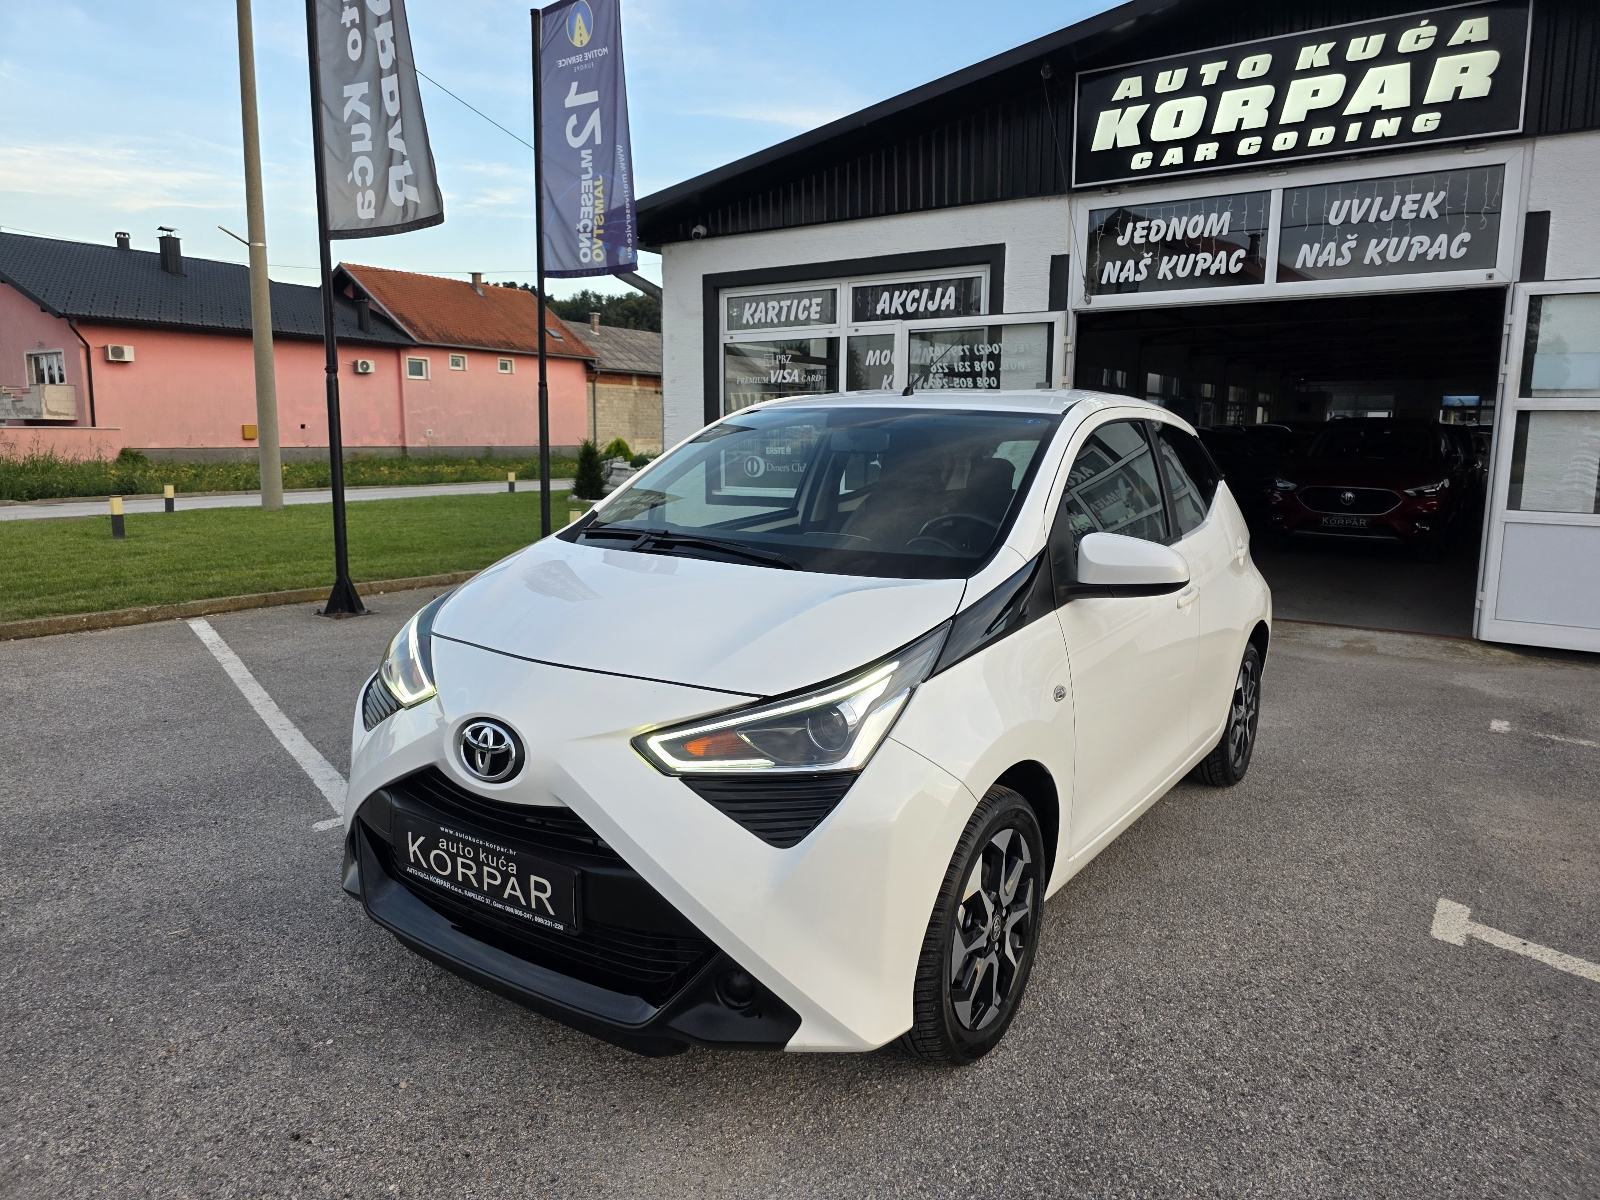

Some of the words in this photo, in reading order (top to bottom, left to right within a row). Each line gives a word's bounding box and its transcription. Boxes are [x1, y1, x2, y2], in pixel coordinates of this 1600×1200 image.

[1112, 53, 1273, 102] AUTO
[1295, 16, 1490, 71] KUĆA
[1090, 50, 1501, 152] KORPAR
[1131, 142, 1220, 170] CAR
[1237, 112, 1442, 157] CODING
[1328, 191, 1447, 226] UVIJEK
[1116, 211, 1231, 246] JEDNOM
[1101, 251, 1152, 285] NAŠ
[1157, 248, 1246, 281] KUPAC
[1295, 234, 1357, 269] NAŠ
[1363, 232, 1472, 265] KUPAC
[742, 298, 823, 325] KARTICE
[875, 286, 956, 315] AKCIJA
[770, 369, 800, 384] VISA
[776, 354, 792, 364] PBZ
[1322, 515, 1367, 527] KORPAR
[408, 831, 556, 916] KORPAR
[439, 838, 474, 858] auto
[480, 848, 517, 874] kuća
[429, 874, 451, 889] KORPAR
